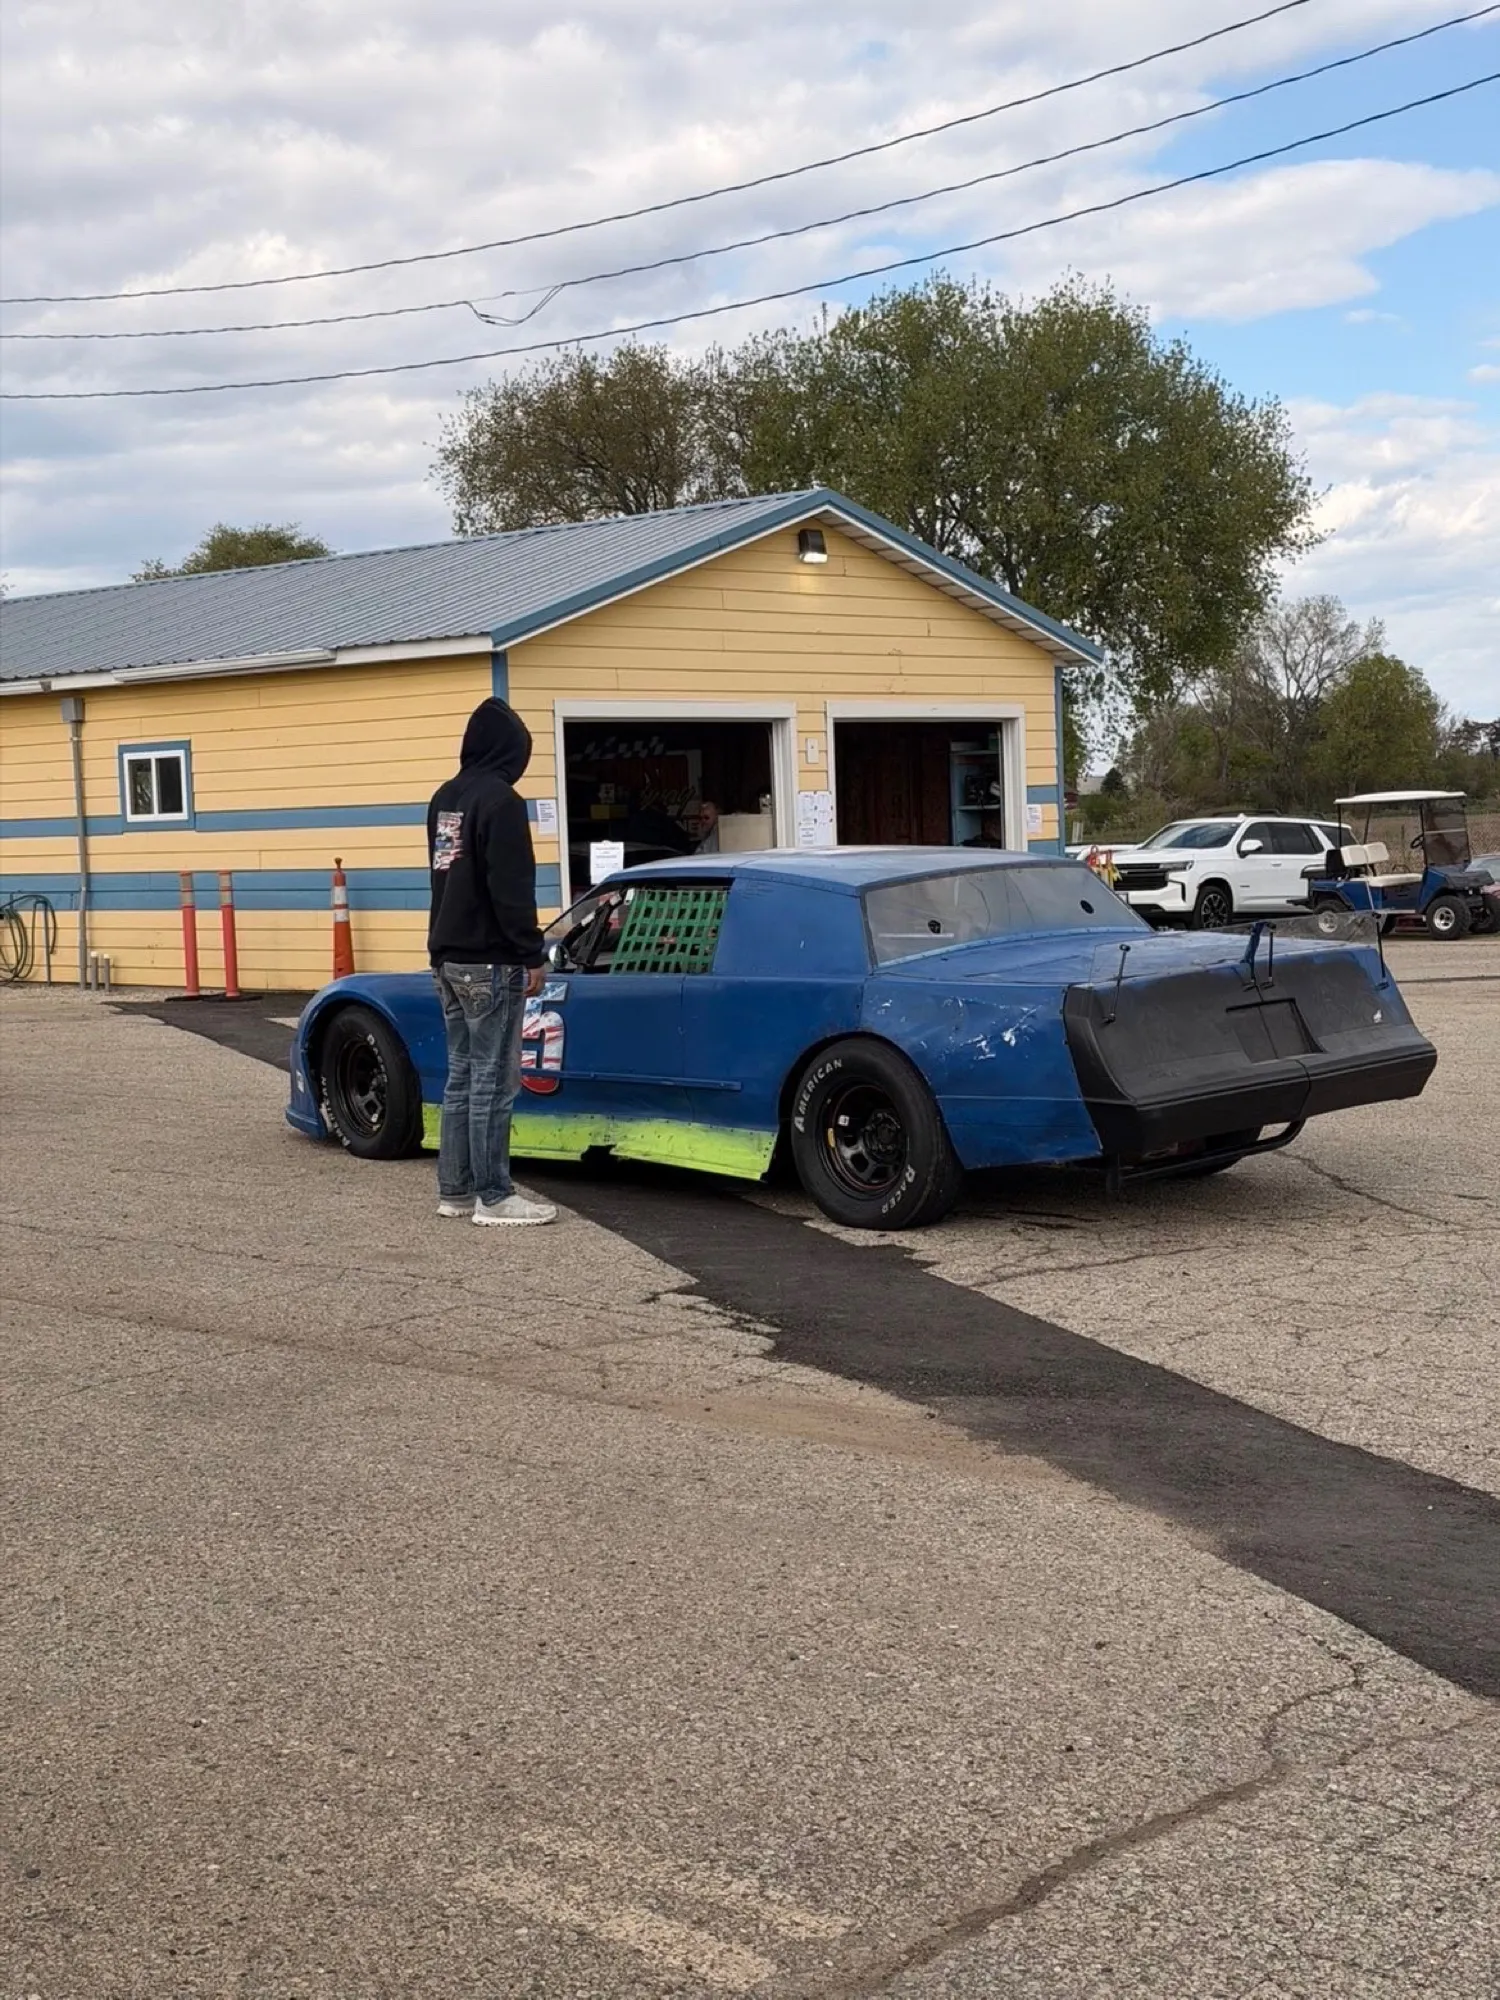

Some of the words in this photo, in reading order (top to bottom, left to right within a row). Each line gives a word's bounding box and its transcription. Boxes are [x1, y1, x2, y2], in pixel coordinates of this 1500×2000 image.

[521, 981, 568, 1092] 5
[795, 1058, 843, 1133] AMERICAN
[881, 1163, 917, 1214] RACER
